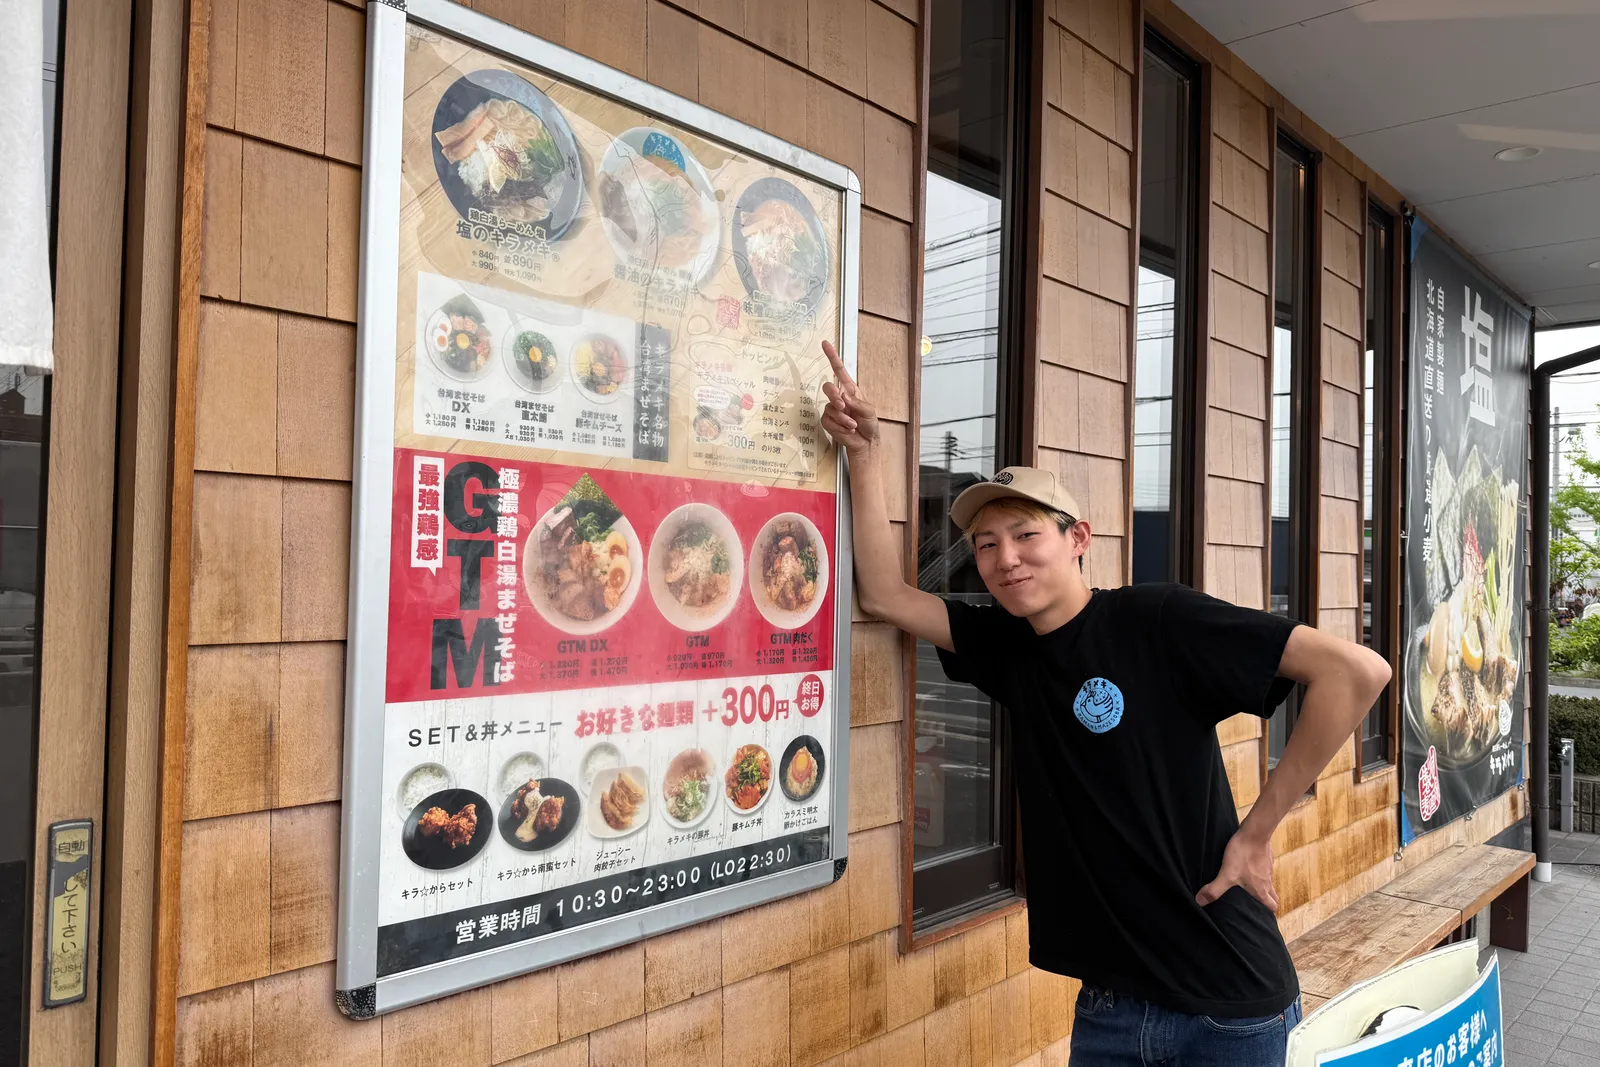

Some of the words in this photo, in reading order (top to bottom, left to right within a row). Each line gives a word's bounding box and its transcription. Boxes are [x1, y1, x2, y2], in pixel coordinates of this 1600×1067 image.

[469, 208, 533, 236] 鶏白湯らーめん
[535, 228, 546, 240] 塩
[478, 250, 500, 263] 840円
[512, 255, 541, 272] 890円
[478, 260, 500, 273] 990円
[516, 269, 542, 283] 1,090円
[1460, 285, 1496, 428] 塩
[437, 388, 486, 403] 台湾まぜそば
[452, 400, 471, 414] DX
[514, 400, 554, 413] 台湾まぜそば
[416, 464, 440, 561] 最強鶏感
[430, 461, 504, 690] GTM
[494, 467, 520, 683] 極濃鶏白湯まぜそば
[557, 640, 586, 654] GTM
[590, 639, 609, 652] DX
[685, 635, 709, 648] GTM
[770, 633, 791, 644] GTM
[801, 680, 820, 695] 終日
[801, 696, 820, 711] お得
[575, 700, 694, 738] お好きな麺類
[732, 818, 762, 833] 豚キムチ丼
[667, 829, 710, 846] キラメキの豚丼
[58, 840, 85, 854] 自動
[596, 847, 631, 861] ジューシー
[593, 855, 636, 872] 肉餃子セット
[61, 880, 78, 954] して下さい
[455, 903, 541, 945] 営業時間
[53, 963, 82, 975] PUSH
